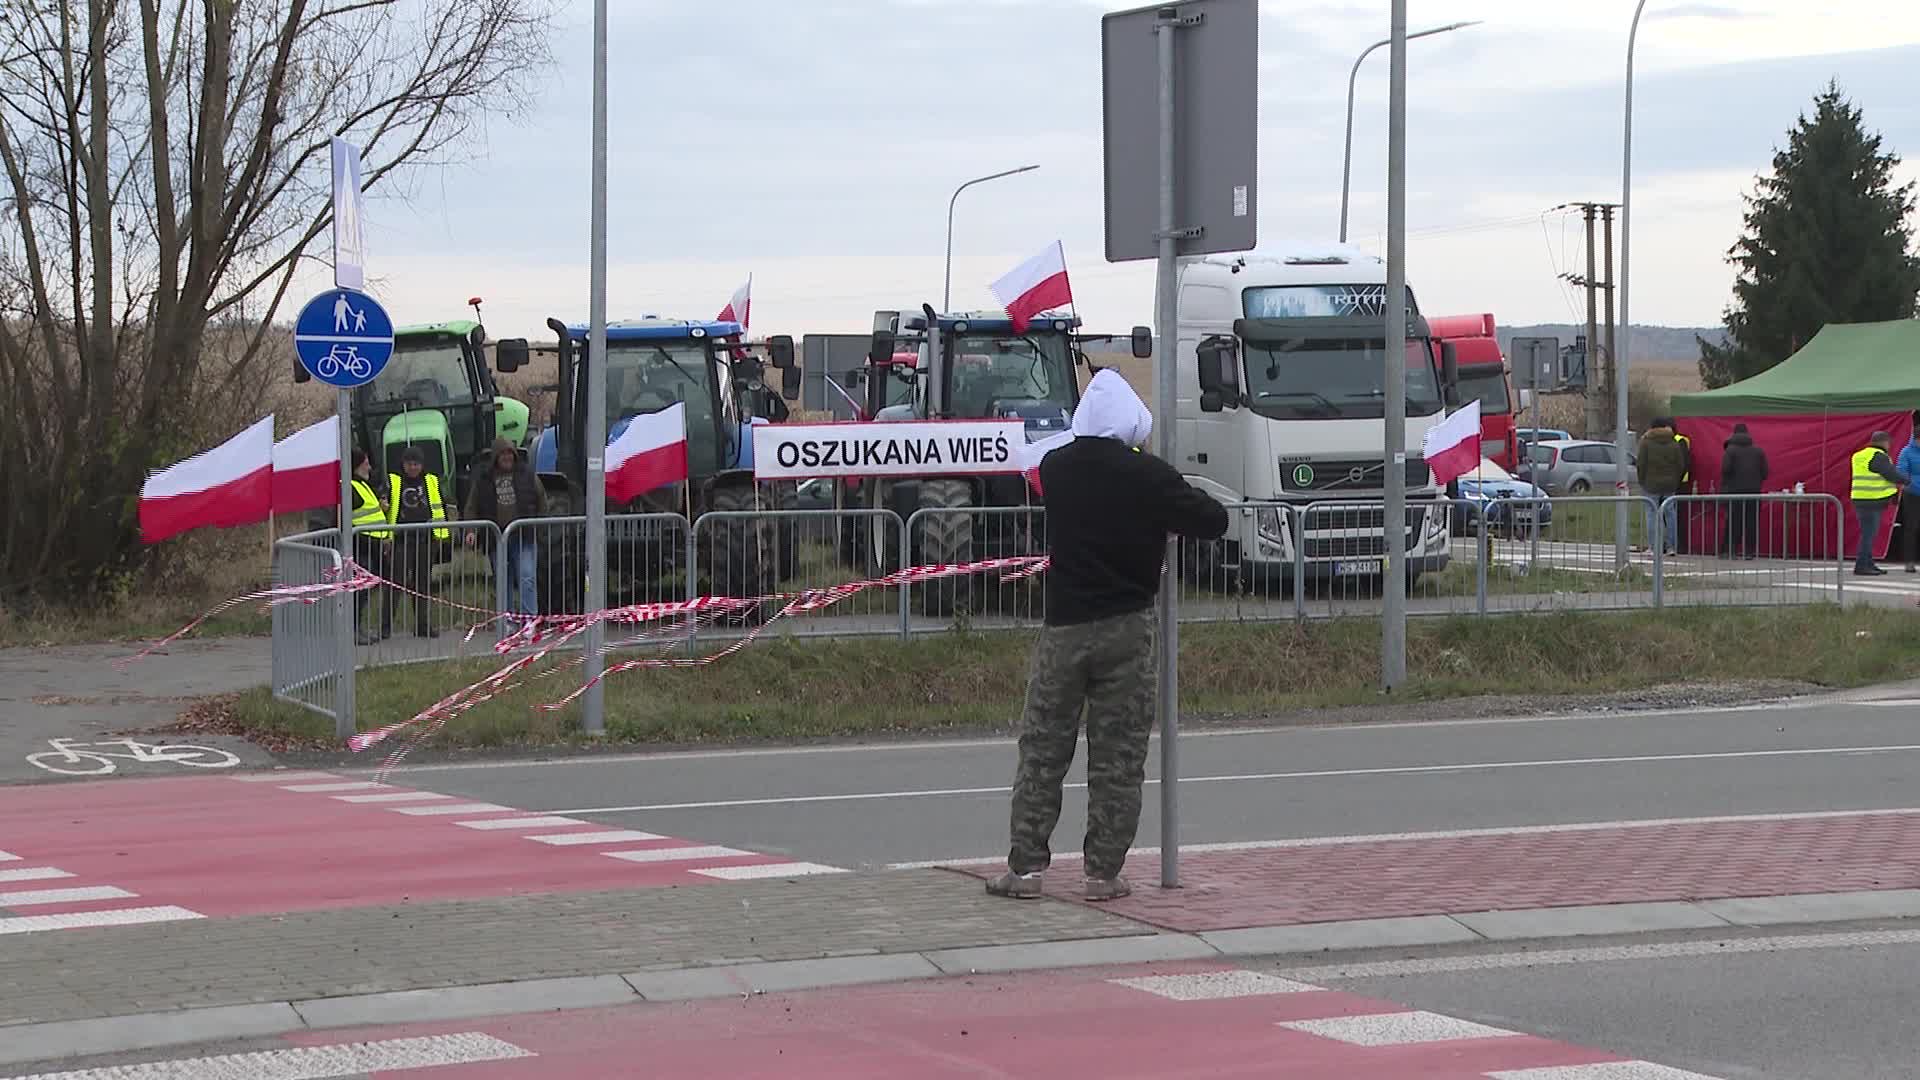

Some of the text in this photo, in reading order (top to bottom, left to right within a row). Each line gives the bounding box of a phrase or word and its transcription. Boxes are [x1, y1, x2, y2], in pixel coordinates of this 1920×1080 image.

[776, 431, 1009, 468] OSZUKANA WIEŚ
[1298, 468, 1309, 483] L
